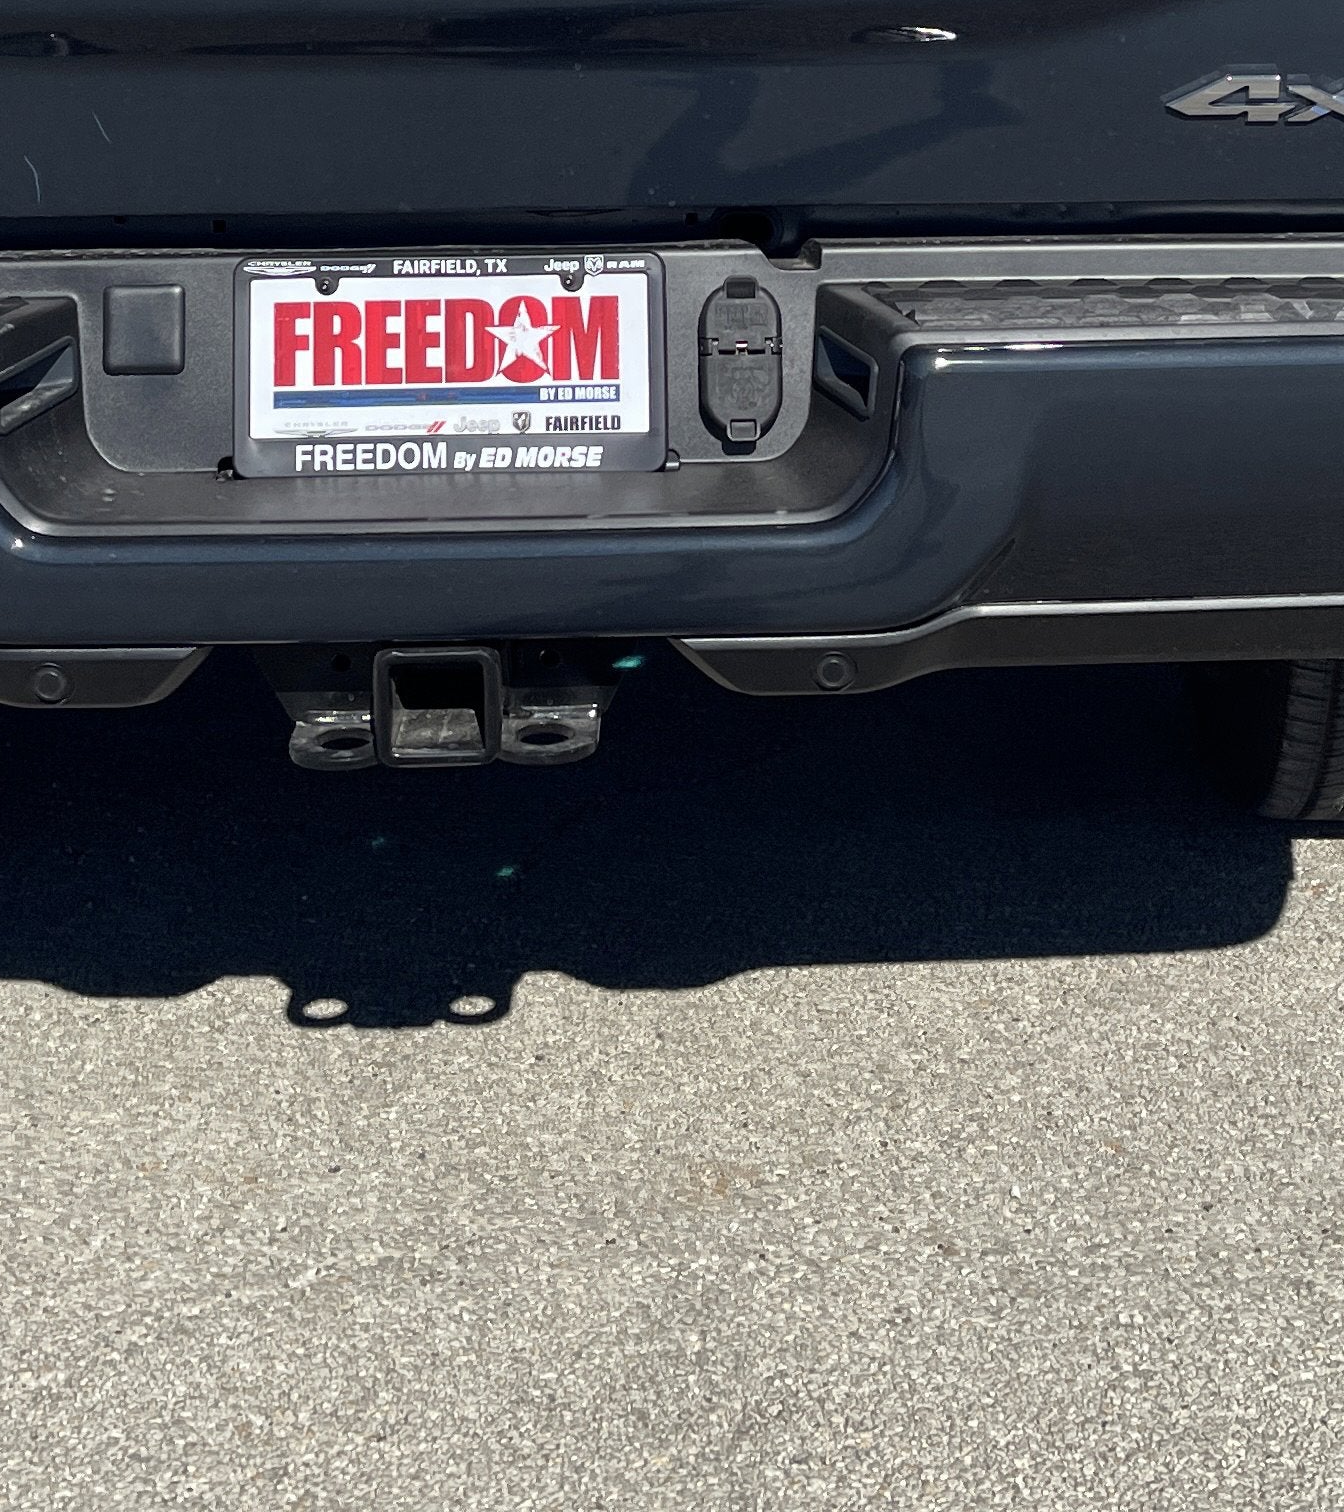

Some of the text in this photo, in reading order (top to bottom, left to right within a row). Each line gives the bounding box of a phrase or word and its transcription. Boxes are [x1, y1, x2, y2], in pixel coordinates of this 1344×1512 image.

[393, 258, 507, 276] FAIRFIELD, TX
[544, 258, 580, 273] Jeep
[606, 260, 645, 269] RAM
[274, 295, 620, 388] FREEDOM
[539, 386, 617, 401] BY ED MORSE
[365, 423, 429, 431] DODGE
[453, 416, 501, 434] Jeep
[545, 414, 622, 432] FAIRFIELD
[295, 441, 604, 472] FREEDOM By ED MORSE
